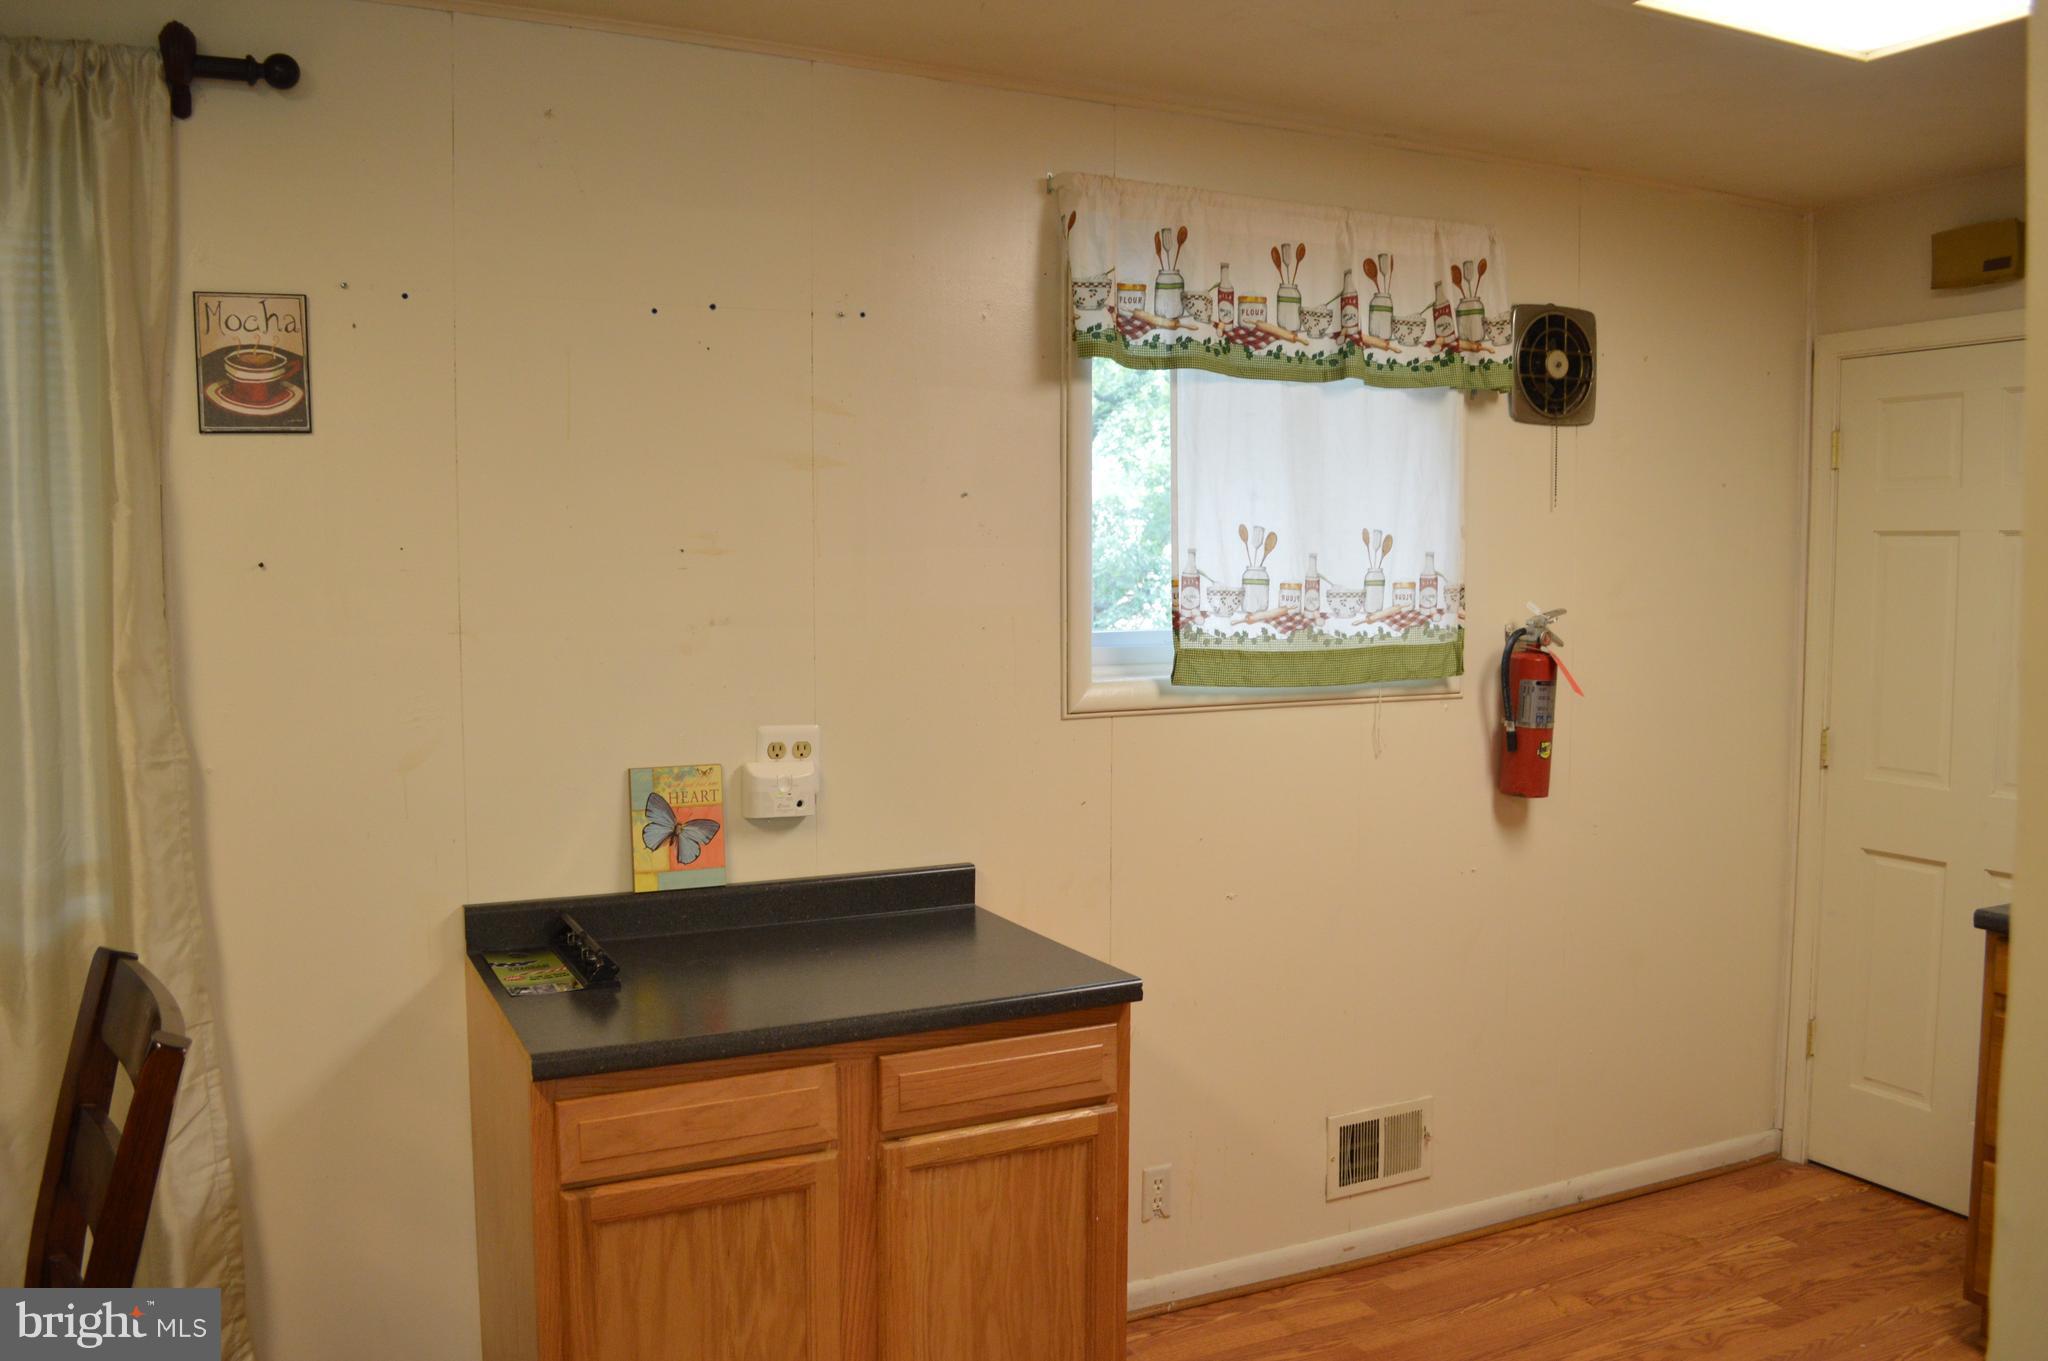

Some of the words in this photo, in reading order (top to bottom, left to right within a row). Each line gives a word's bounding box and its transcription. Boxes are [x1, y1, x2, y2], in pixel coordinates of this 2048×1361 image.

[1119, 295, 1143, 304] FLOUR
[204, 300, 298, 336] Mocha
[1241, 308, 1264, 317] FLOUR
[668, 788, 720, 805] HEART
